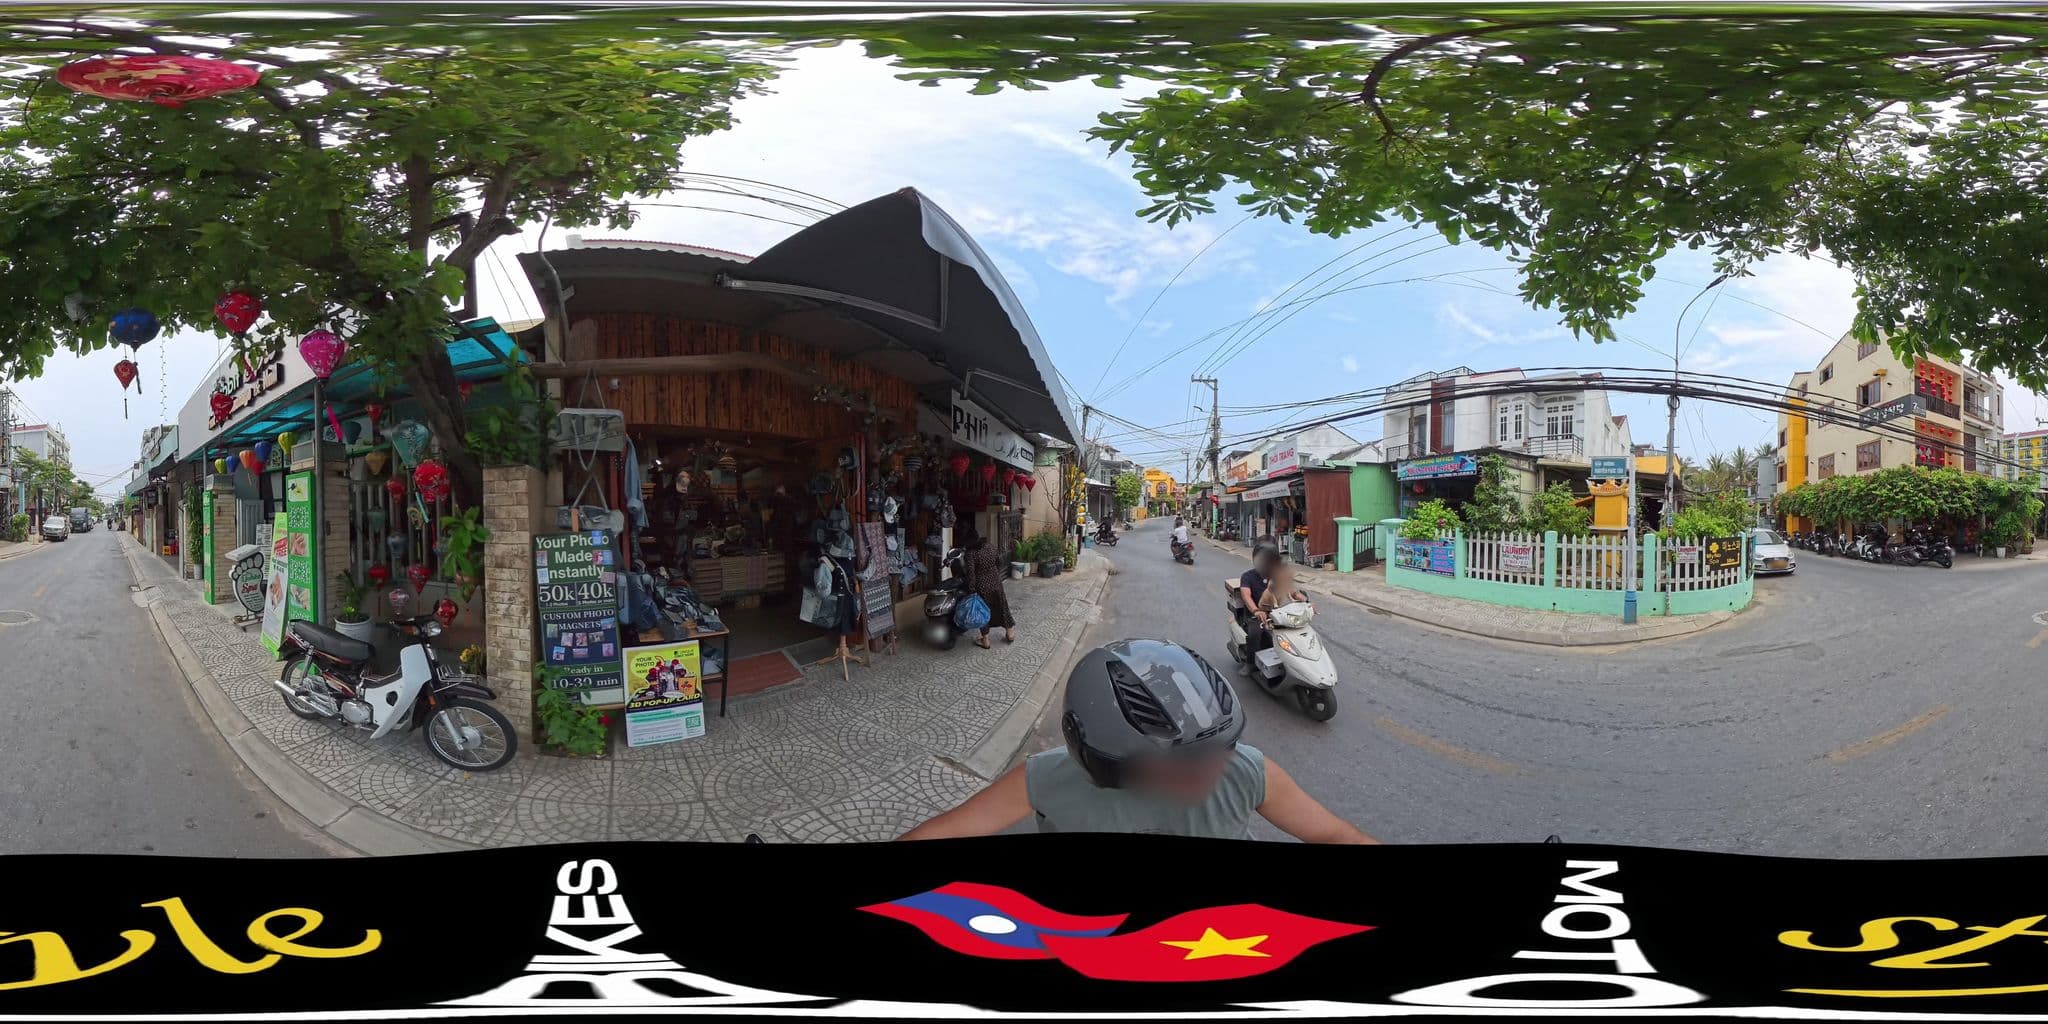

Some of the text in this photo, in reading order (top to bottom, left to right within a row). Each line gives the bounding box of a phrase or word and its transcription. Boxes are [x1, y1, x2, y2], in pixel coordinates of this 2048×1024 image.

[536, 532, 610, 550] Your Phoo
[555, 551, 593, 563] Made
[549, 564, 605, 580] nstantly
[539, 584, 576, 603] 50k
[578, 581, 614, 600] 40k
[543, 609, 614, 620] CUSTOM PHOTO
[558, 621, 601, 630] MAGNETS
[593, 665, 604, 673] in
[596, 676, 619, 687] min
[629, 692, 701, 709] 3D POP-UP CARD
